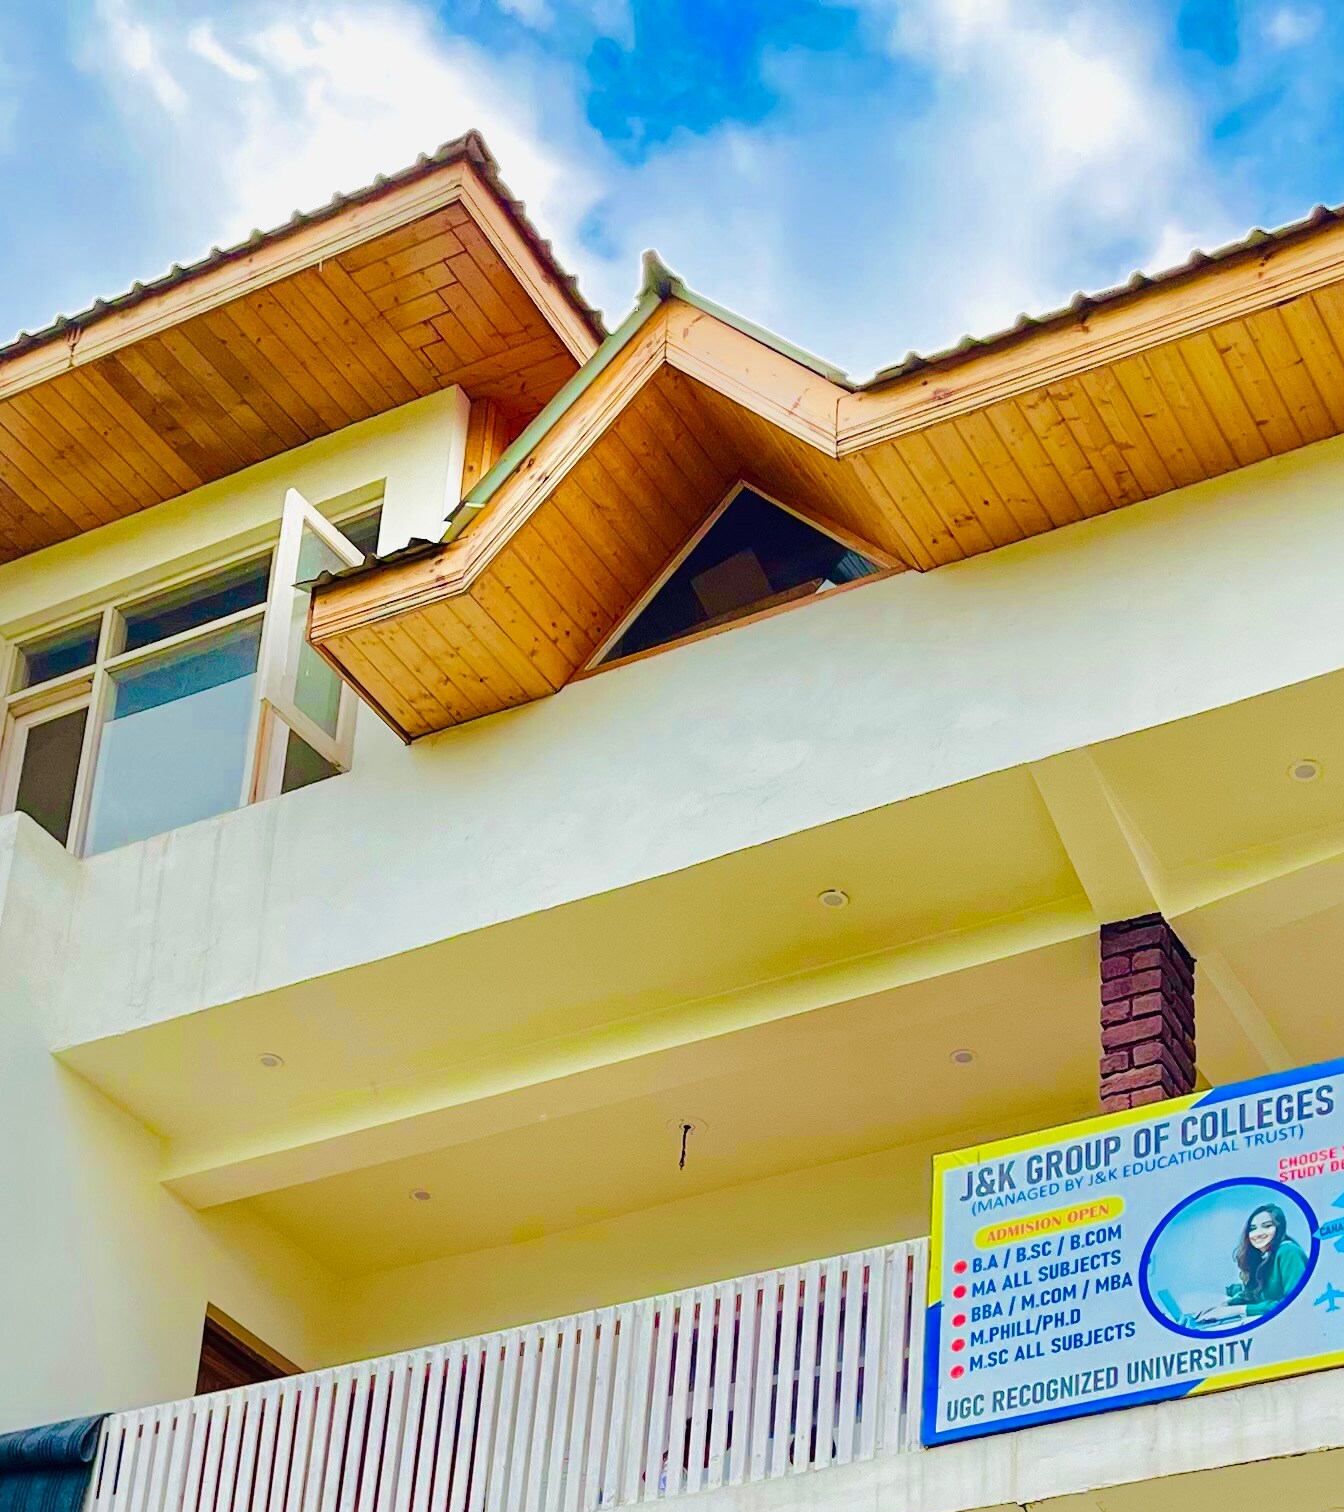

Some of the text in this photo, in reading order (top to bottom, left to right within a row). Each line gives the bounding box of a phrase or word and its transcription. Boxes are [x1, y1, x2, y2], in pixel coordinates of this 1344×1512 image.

[959, 1084, 1335, 1202] J&K GROUP OF COLLEGES
[1279, 1147, 1337, 1170] CHOOSE
[971, 1125, 1305, 1216] (MANAGED BY J&K EDUCATIONAL TRUST)
[1279, 1164, 1324, 1183] STUDY
[987, 1203, 1109, 1244] ADMISION OPEN
[972, 1224, 1122, 1273] B.A / B.SC / B.COM
[971, 1272, 1133, 1322] BBA / M.COM / MBA
[972, 1249, 1122, 1298] MA ALL SUBJECTS
[969, 1321, 1136, 1372] M.SC ALL SUBJECTS
[970, 1308, 1081, 1347] M.PHILL/PH.D
[946, 1338, 1254, 1422] UGC RECOGNIZED UNIVERSITY
